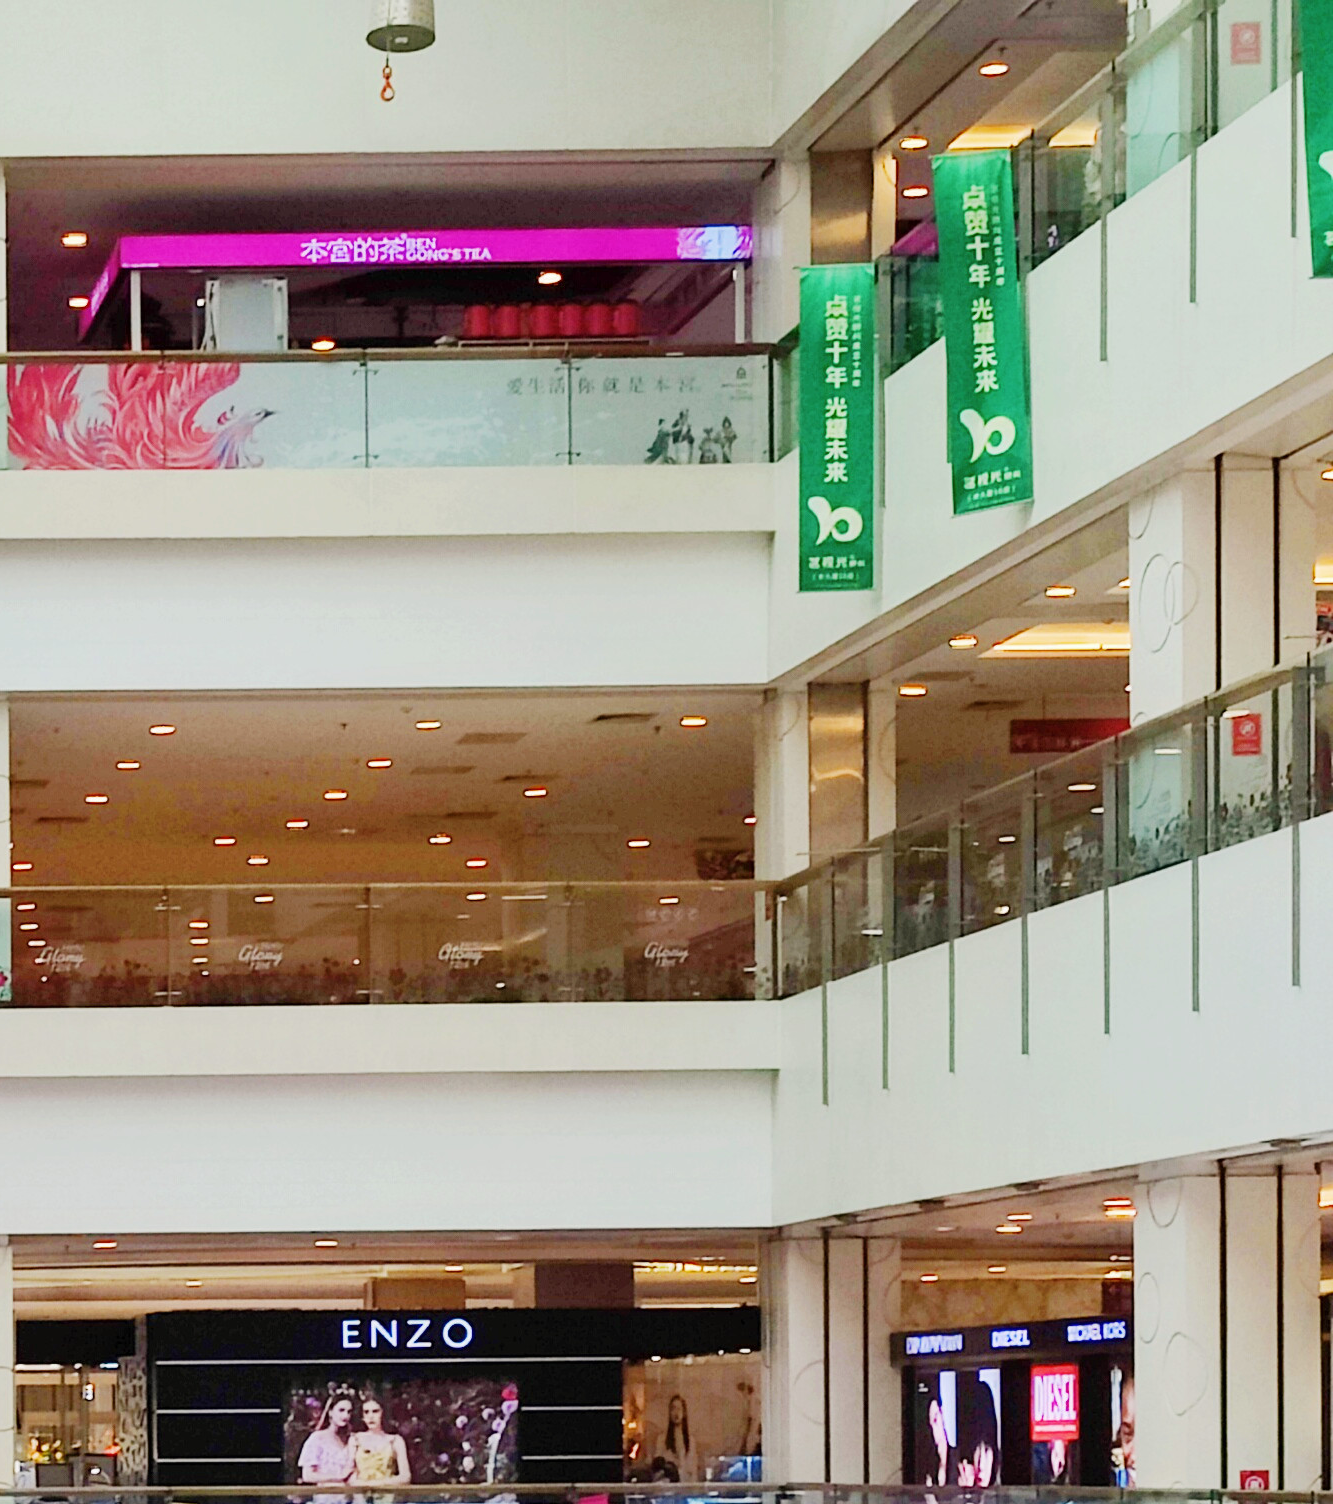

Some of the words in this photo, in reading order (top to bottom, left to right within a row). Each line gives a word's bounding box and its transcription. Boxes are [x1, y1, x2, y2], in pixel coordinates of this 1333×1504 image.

[962, 185, 991, 289] 点赞十年
[825, 294, 848, 389] 点赞十年
[341, 1317, 474, 1349] ENZO
[991, 1328, 1031, 1348] DIESEL
[1034, 1374, 1077, 1422] DIESEL
